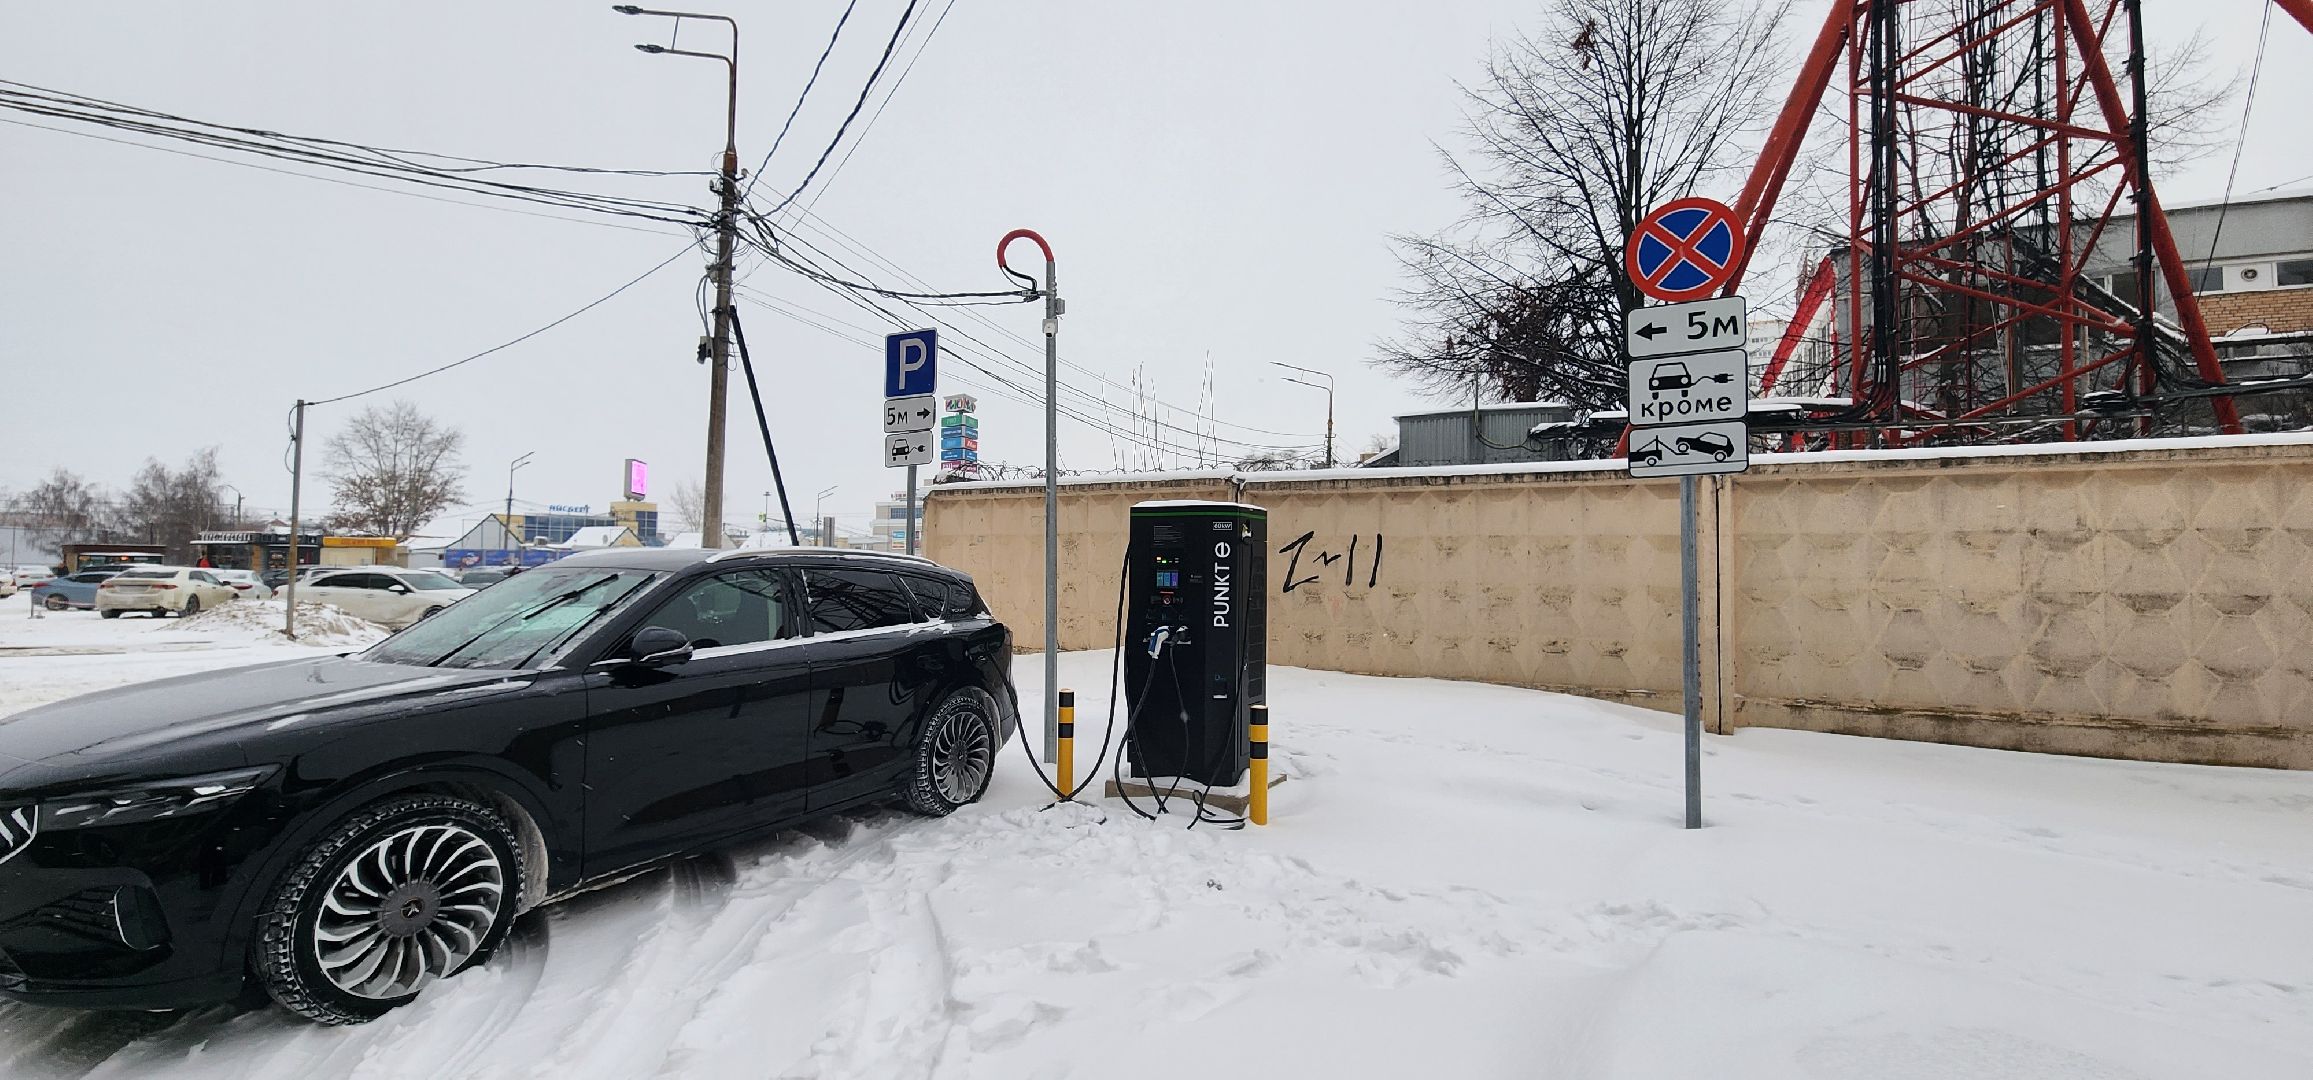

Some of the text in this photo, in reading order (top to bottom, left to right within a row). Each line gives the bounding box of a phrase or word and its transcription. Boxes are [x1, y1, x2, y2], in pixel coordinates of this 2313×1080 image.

[1687, 311, 1739, 340] 5м
[899, 338, 927, 390] P
[886, 407, 908, 426] 5м
[1641, 396, 1732, 421] кроме
[1213, 562, 1230, 628] PUNKT
